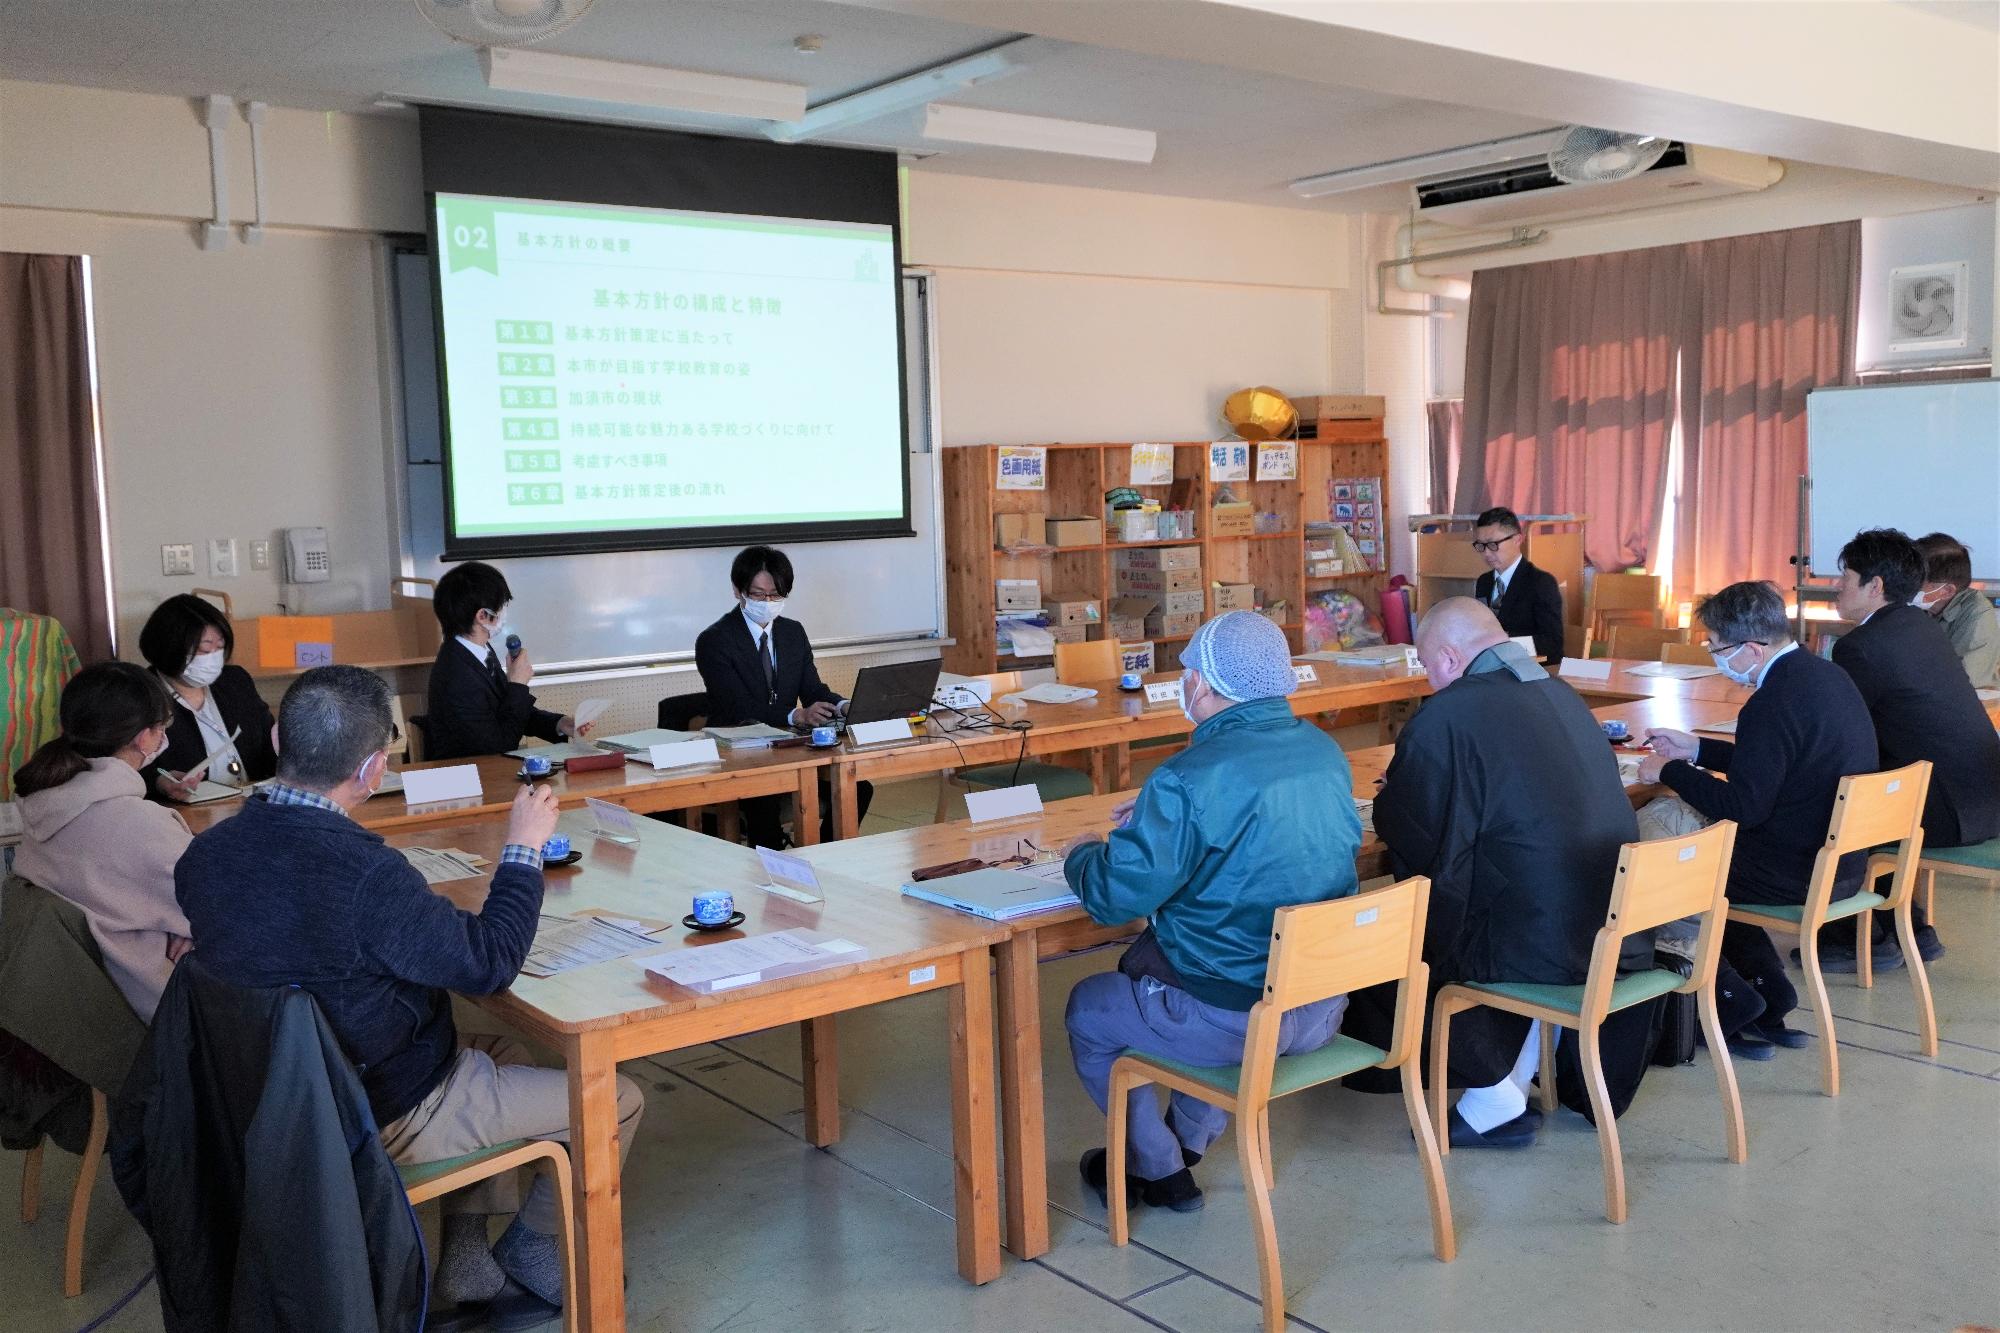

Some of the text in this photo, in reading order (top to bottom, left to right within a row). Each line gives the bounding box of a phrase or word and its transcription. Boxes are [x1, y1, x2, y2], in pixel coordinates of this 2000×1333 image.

[454, 225, 489, 249] 02
[517, 231, 632, 253] 基本方針の概要
[593, 288, 783, 316] 基本方針の構成と特徴
[499, 323, 735, 345] 第1章 基本方針策定に当たって
[501, 355, 751, 377] 第2章 本市が目指す学校教育の姿
[503, 388, 663, 407] 第3章 加須市の現状
[506, 420, 836, 439] 第4章 持続可能な魅力ある学校づくりに向けて
[508, 452, 668, 471] 第5章 考慮すべき事項
[1001, 457, 1042, 476] 色画用紙
[510, 481, 727, 504] 第6章 基本方針策定後の流れ
